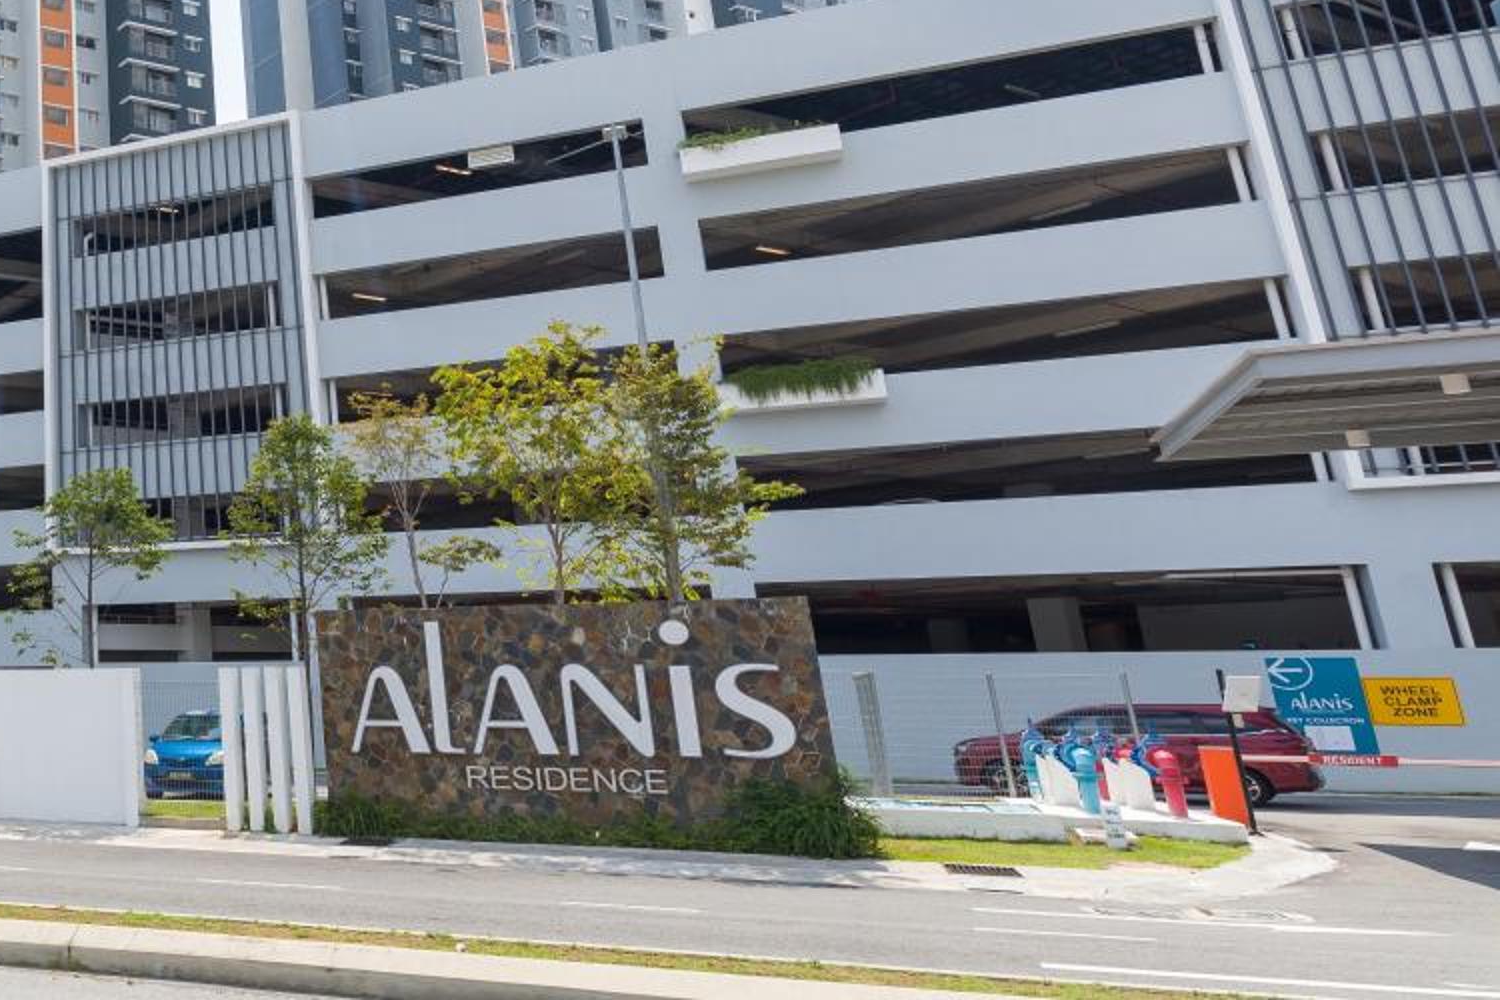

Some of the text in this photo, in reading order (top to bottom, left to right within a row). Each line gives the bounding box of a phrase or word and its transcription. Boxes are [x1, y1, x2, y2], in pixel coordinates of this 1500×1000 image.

[1380, 686, 1440, 696] WHEEL
[1383, 697, 1442, 707] CLAMP
[1391, 708, 1439, 718] ZONE
[466, 764, 669, 795] RESIDENCE
